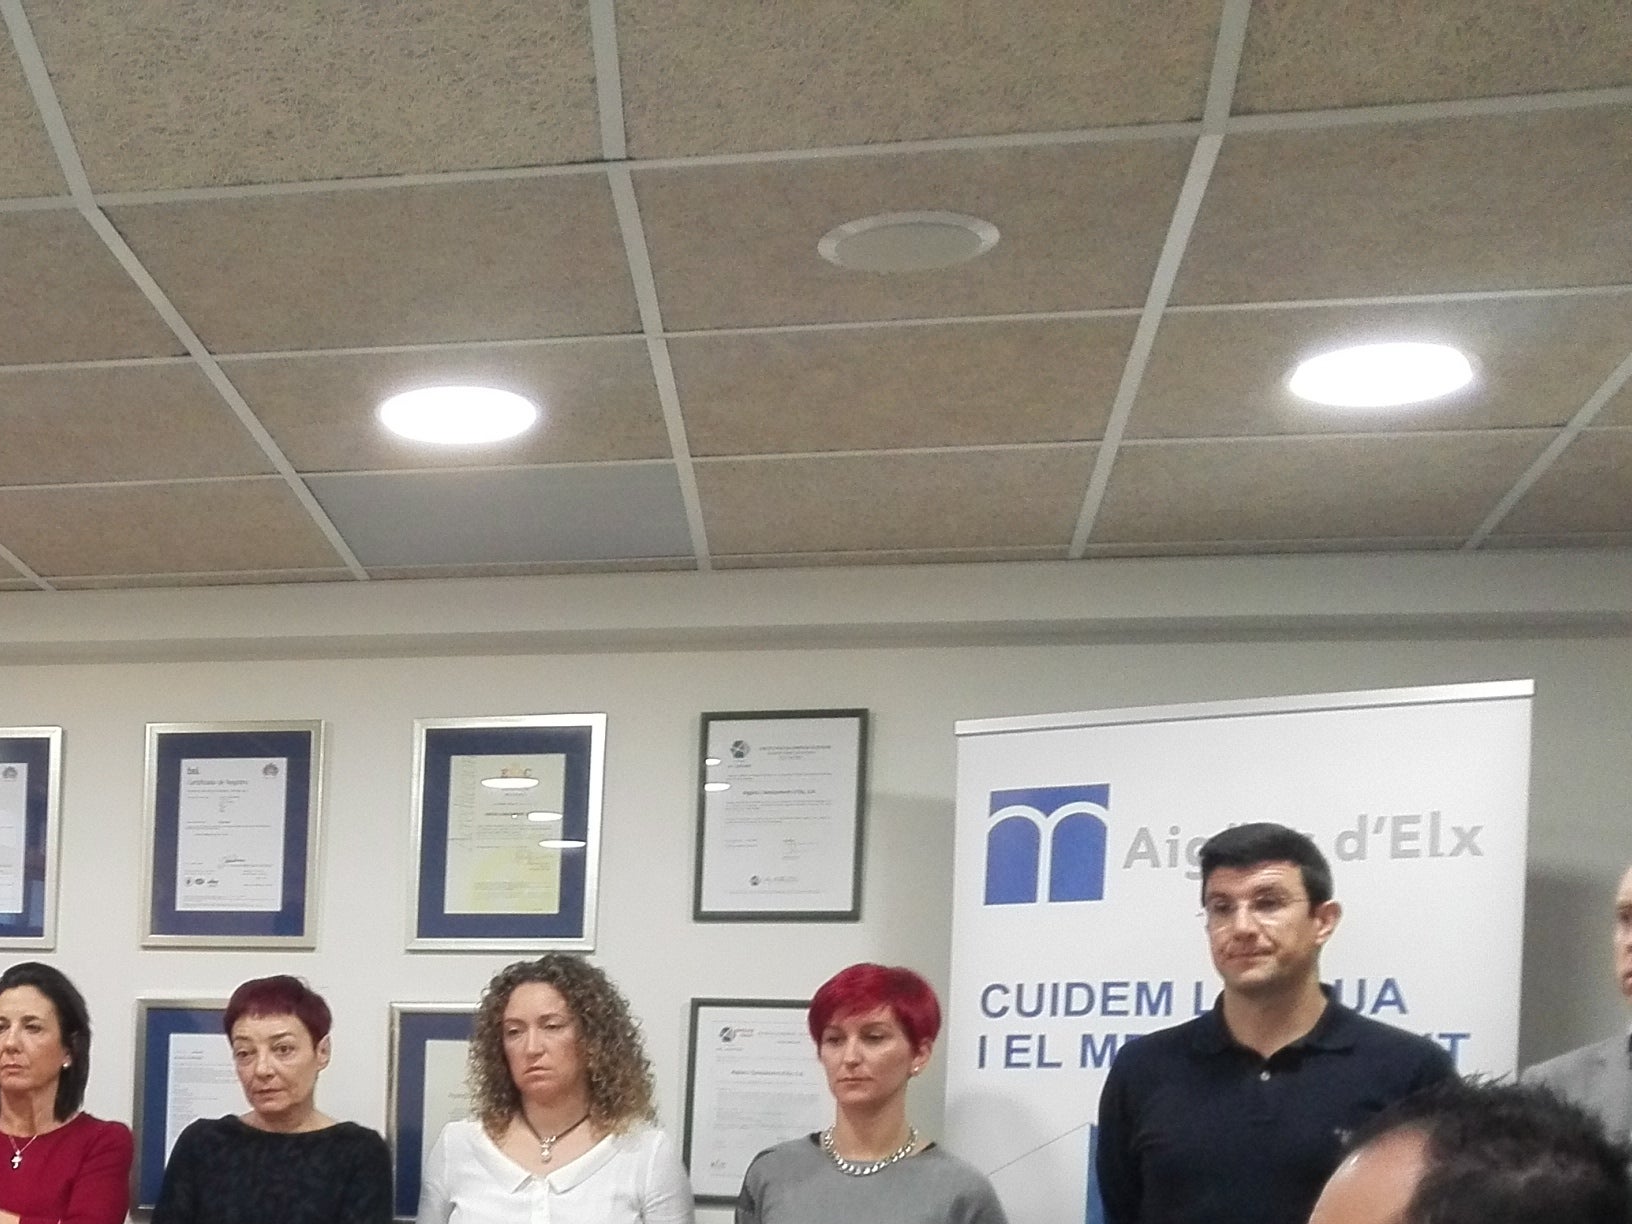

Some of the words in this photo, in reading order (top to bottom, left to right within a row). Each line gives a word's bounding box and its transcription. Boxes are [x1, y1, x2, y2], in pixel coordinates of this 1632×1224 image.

[1334, 811, 1484, 862] d'Elx
[980, 981, 1174, 1019] CUIDEM
[978, 1034, 988, 1069] I
[1004, 1034, 1063, 1069] EL
